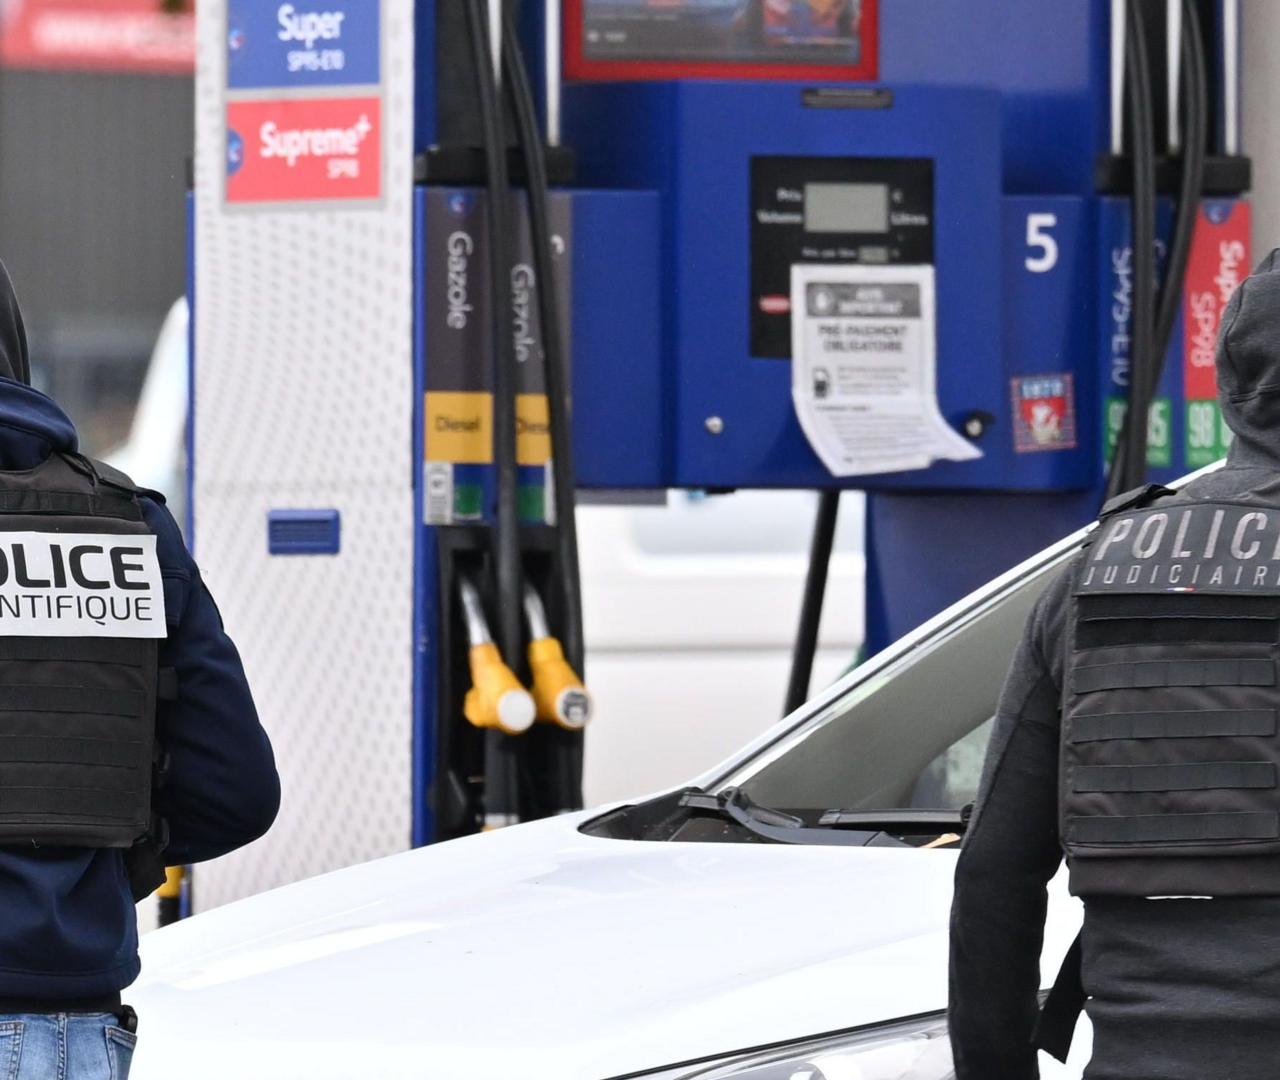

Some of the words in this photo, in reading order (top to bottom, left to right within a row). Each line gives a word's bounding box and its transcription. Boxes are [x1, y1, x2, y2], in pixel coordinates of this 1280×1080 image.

[277, 2, 345, 49] Super
[1024, 212, 1059, 273] 5
[446, 230, 474, 330] Gazole
[1189, 290, 1217, 369] SP98
[435, 412, 481, 433] Diesel
